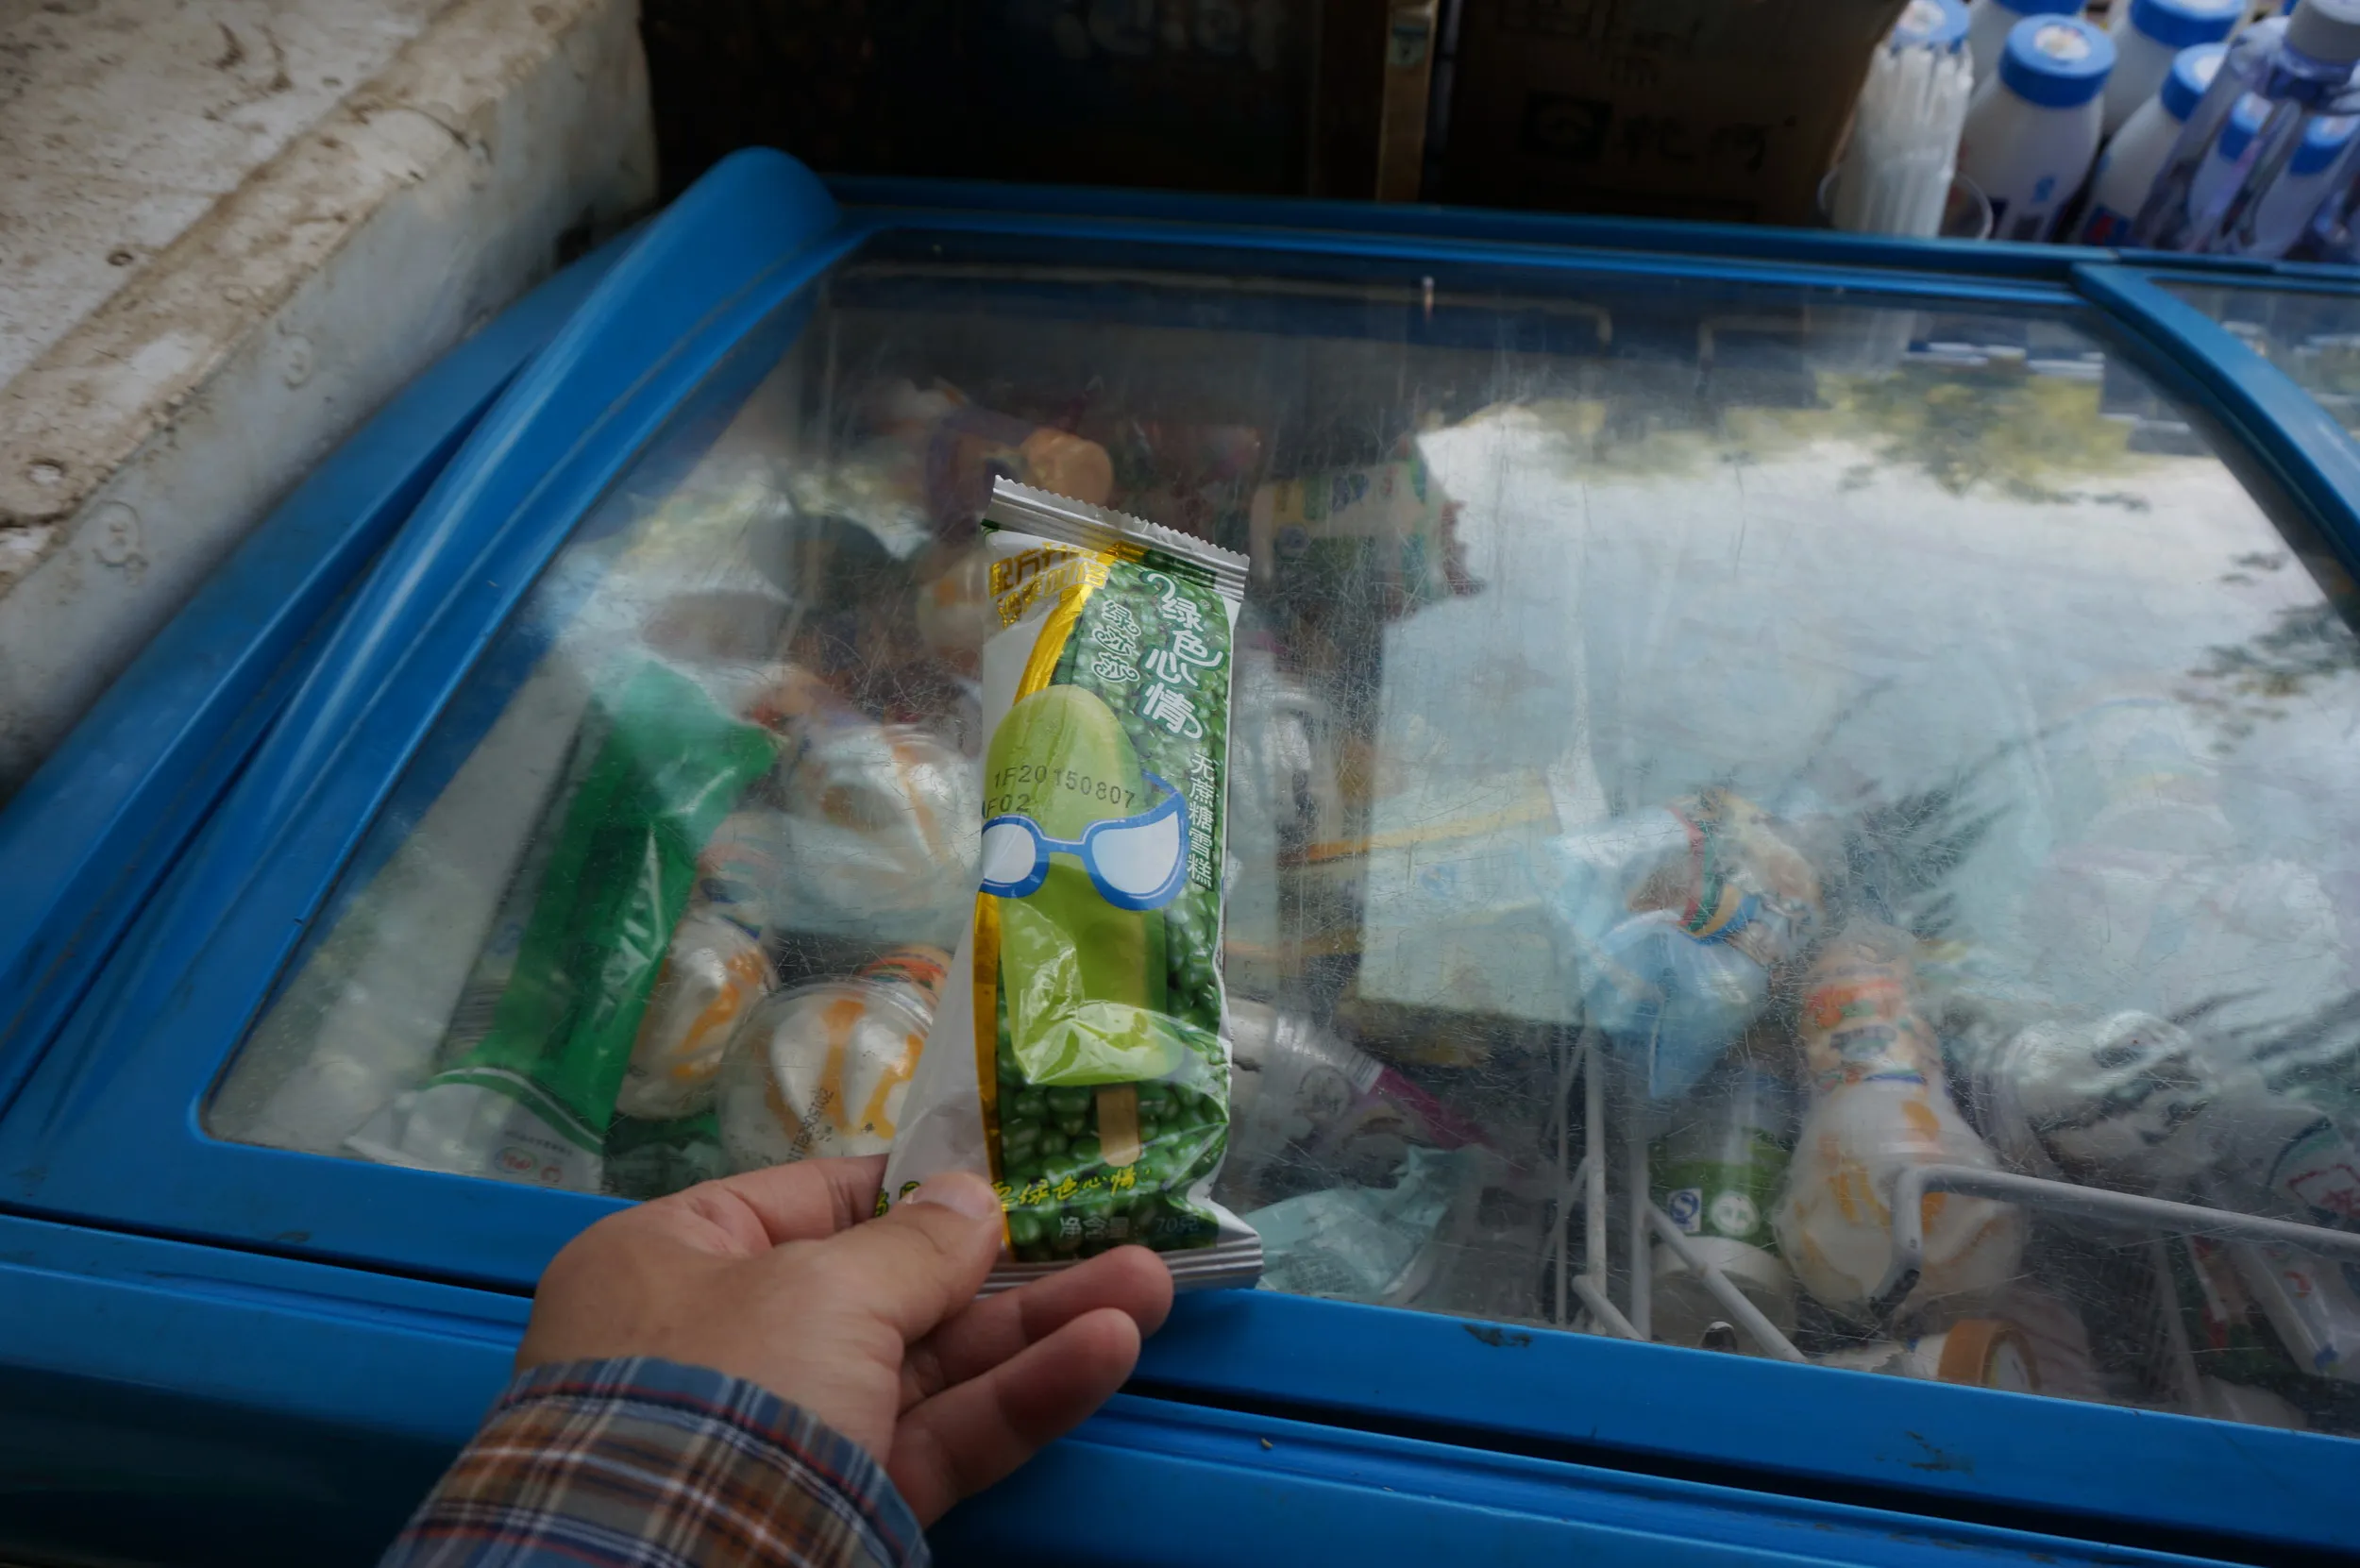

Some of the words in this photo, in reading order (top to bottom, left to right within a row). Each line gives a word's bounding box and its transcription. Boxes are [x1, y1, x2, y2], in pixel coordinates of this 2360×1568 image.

[1142, 573, 1223, 739] 绿色心情
[1187, 751, 1215, 889] 无蔗糖雪糕
